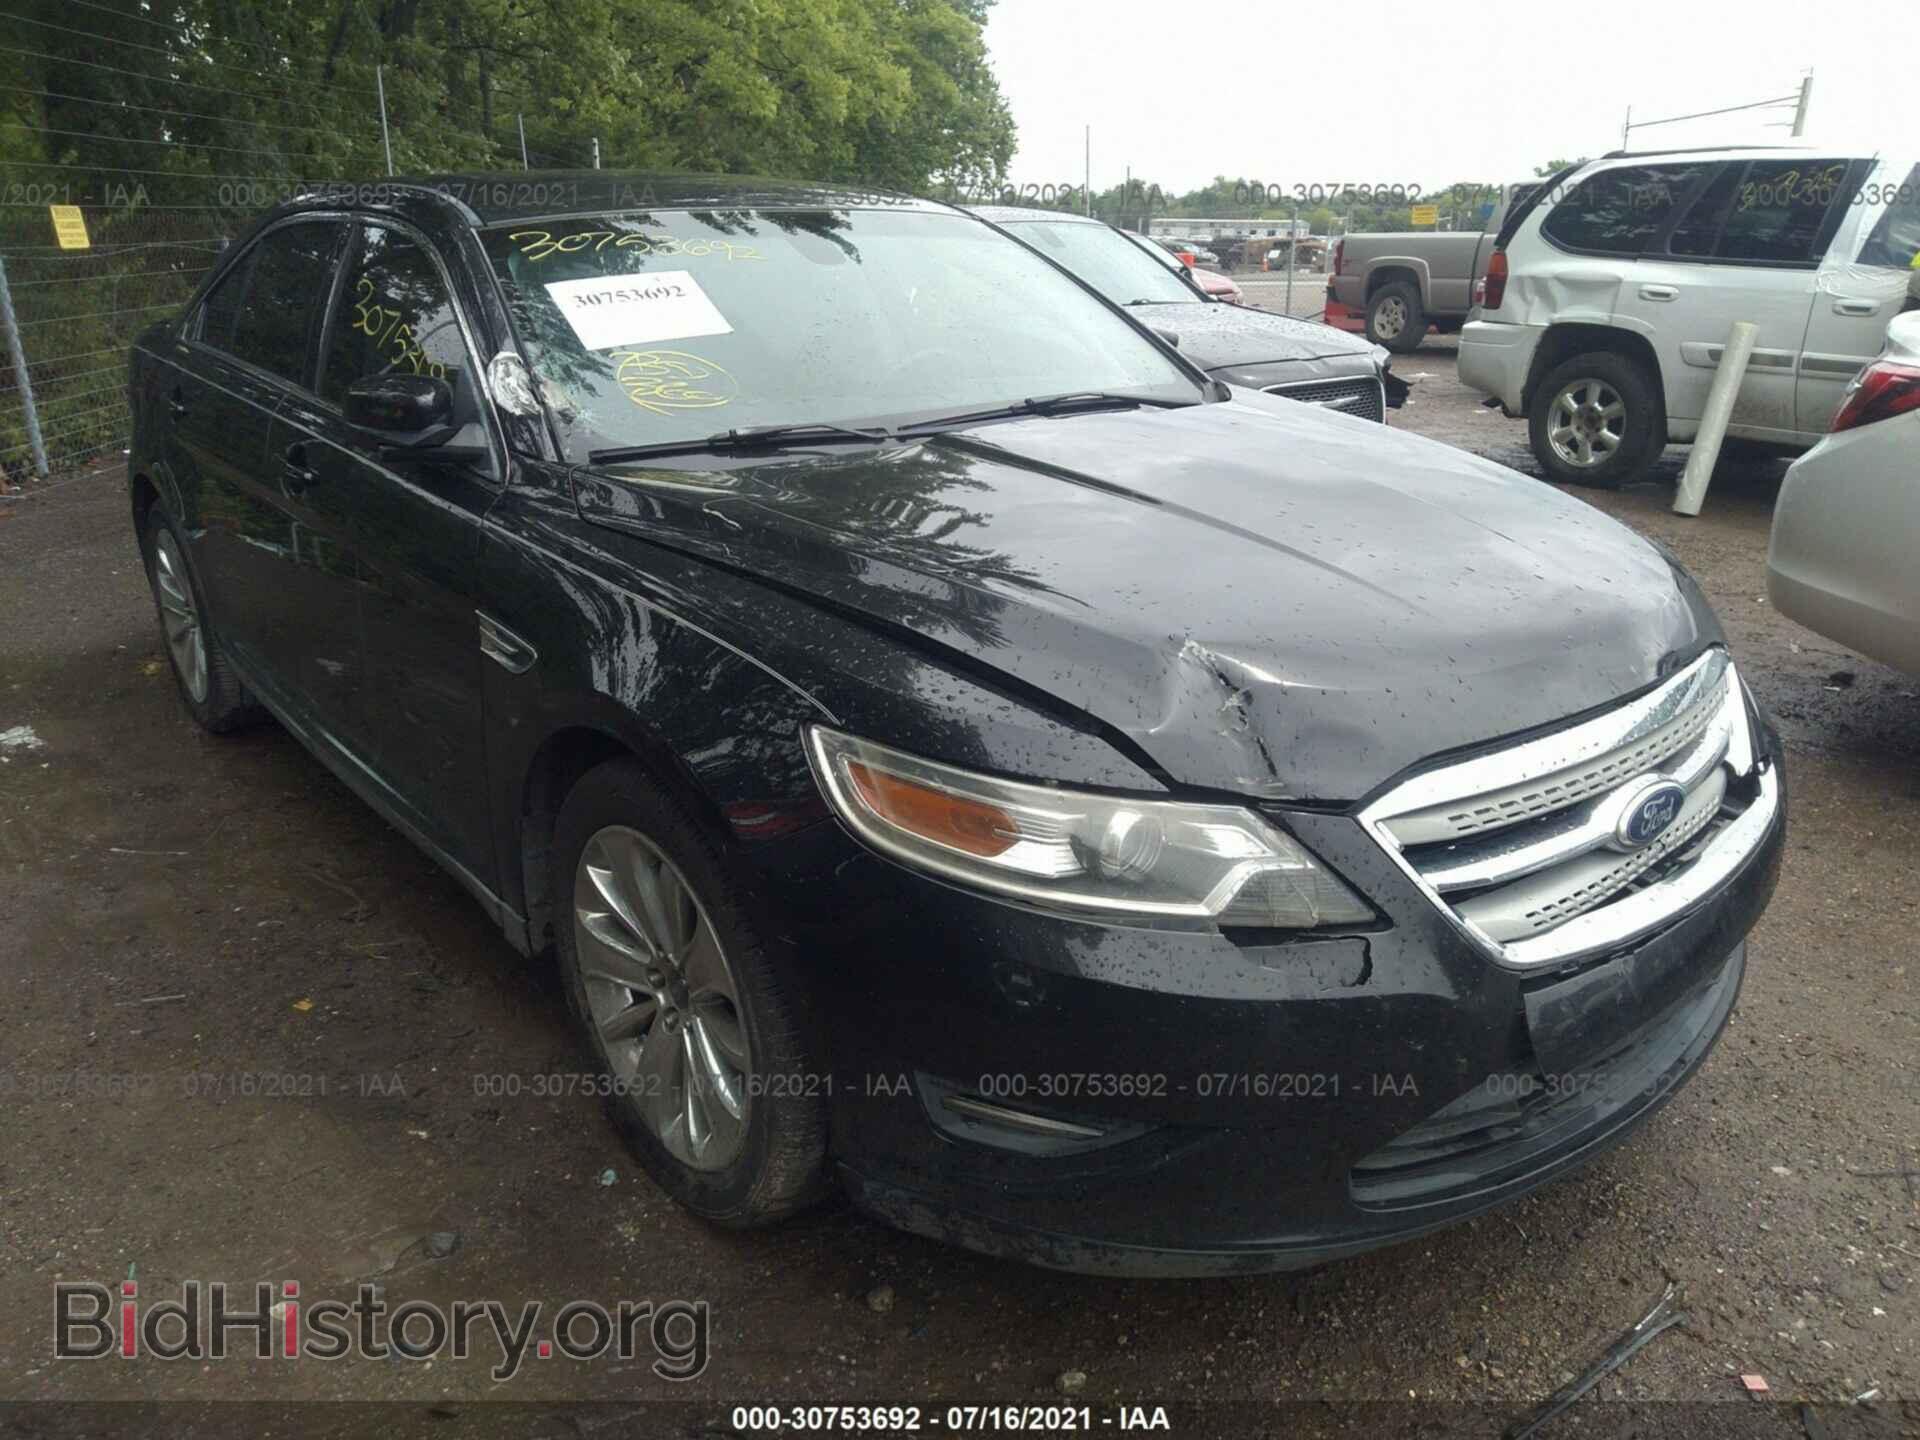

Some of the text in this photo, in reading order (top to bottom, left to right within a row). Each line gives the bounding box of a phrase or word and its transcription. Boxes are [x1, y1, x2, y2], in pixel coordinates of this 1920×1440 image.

[509, 231, 768, 261] 30753692
[573, 284, 687, 309] 30753692
[1640, 795, 1675, 836] Ford
